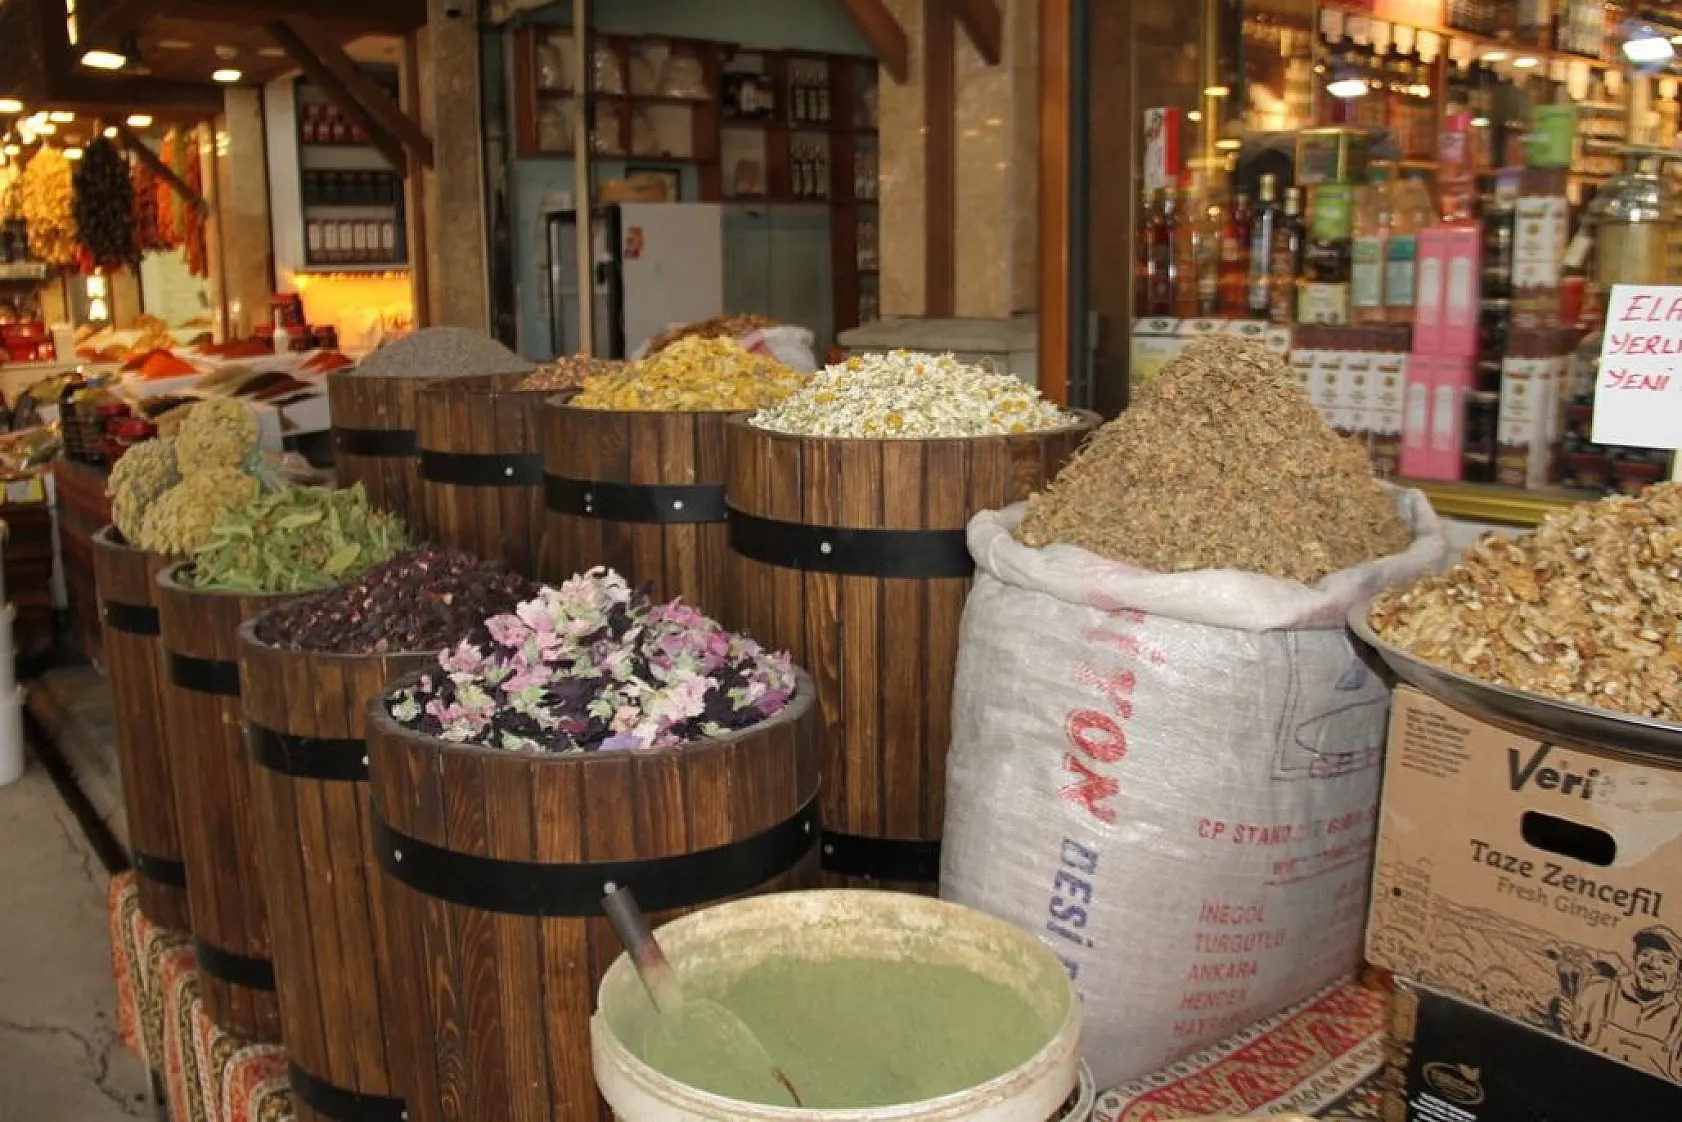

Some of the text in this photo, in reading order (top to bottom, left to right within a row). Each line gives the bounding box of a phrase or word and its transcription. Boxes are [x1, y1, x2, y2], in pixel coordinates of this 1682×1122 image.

[1508, 742, 1600, 799] Veri
[1470, 838, 1663, 917] Taze Zencefil
[1496, 875, 1623, 929] Fresh Ginger
[1188, 959, 1259, 981] ANKARA
